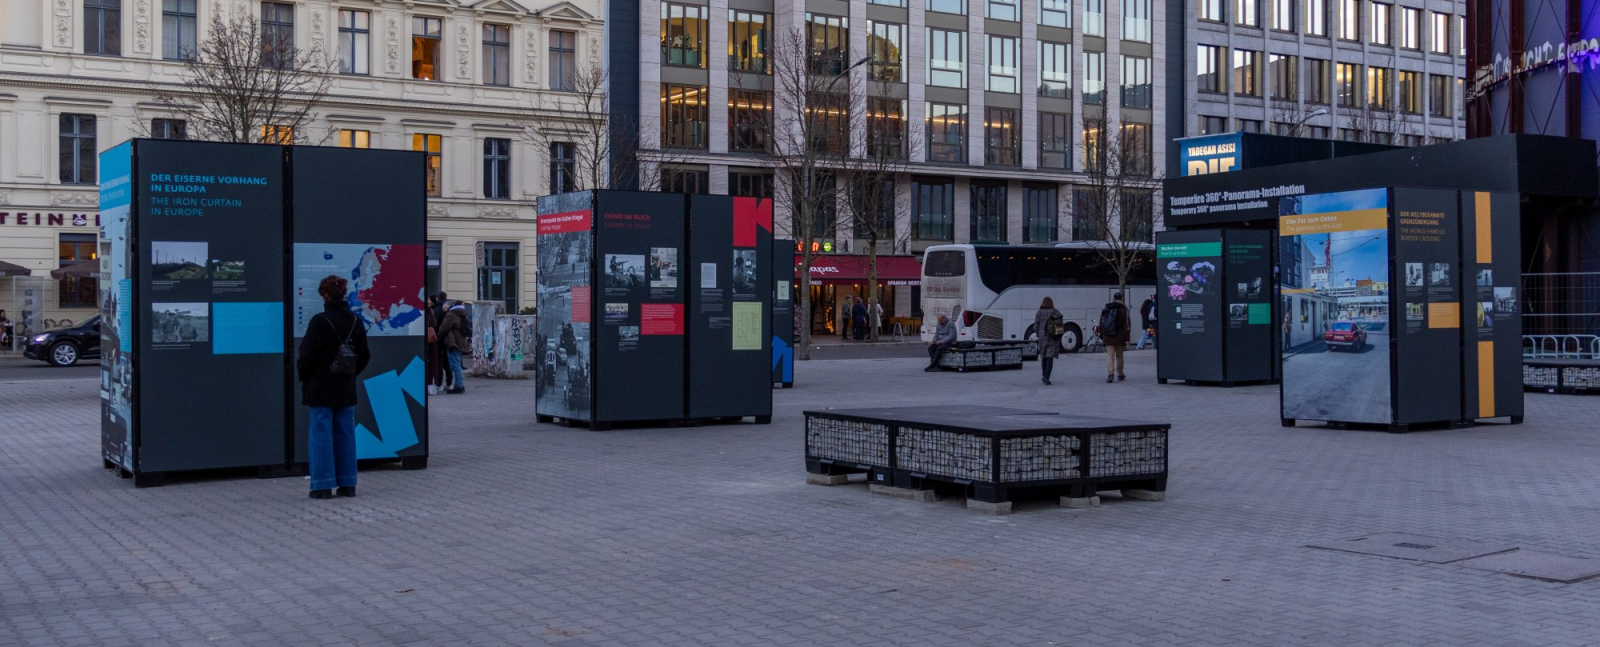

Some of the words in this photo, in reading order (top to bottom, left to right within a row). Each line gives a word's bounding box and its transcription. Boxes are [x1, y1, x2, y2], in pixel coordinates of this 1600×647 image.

[1188, 145, 1217, 157] YADEGAR
[1217, 143, 1236, 154] ASISI
[151, 174, 172, 182] DER
[175, 175, 216, 184] EISERNE
[218, 177, 268, 186] VORHANG
[151, 184, 162, 192] IN
[165, 185, 207, 193] EUROPA
[151, 197, 170, 206] THE
[173, 198, 198, 206] IRON
[201, 199, 243, 207] CURTAIN
[1170, 193, 1205, 206] Temporäre
[151, 208, 162, 216] IN
[165, 208, 204, 217] EUROPE
[1170, 207, 1197, 216] Temporary
[1197, 205, 1209, 213] 360°
[1209, 203, 1237, 213] panorama
[633, 213, 652, 221] BLICK
[1320, 215, 1338, 223] Osten
[1410, 211, 1445, 219] WELTBEKANNTE
